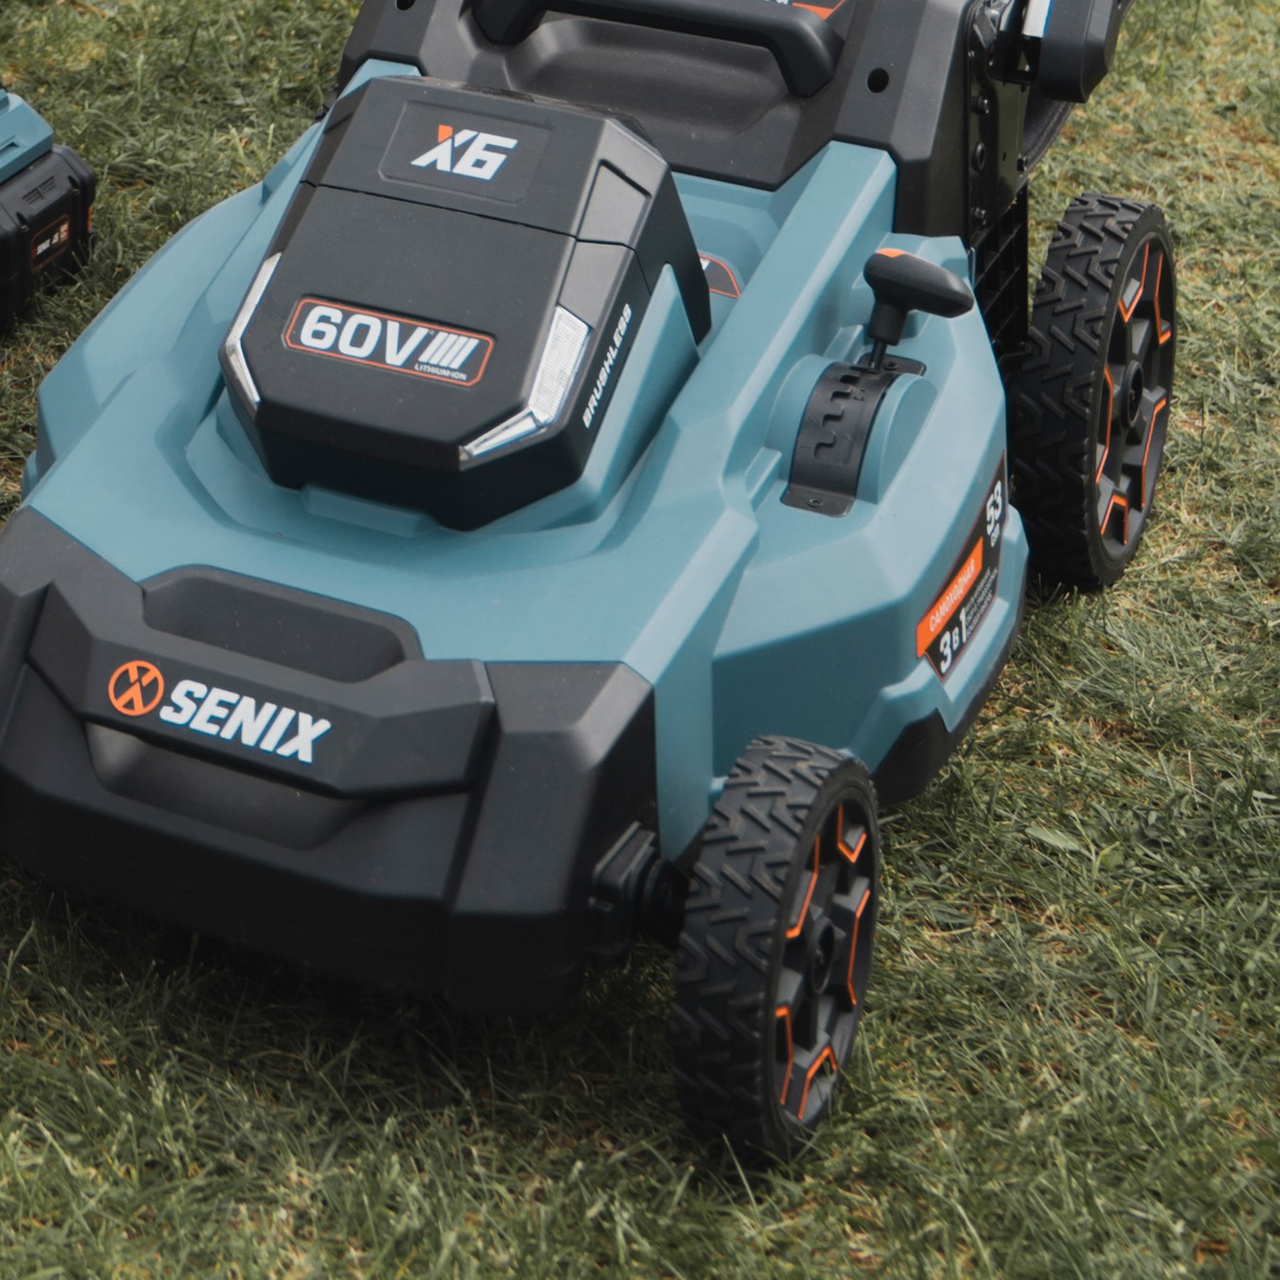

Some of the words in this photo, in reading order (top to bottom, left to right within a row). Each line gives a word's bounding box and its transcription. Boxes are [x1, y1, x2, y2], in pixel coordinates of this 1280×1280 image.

[410, 124, 519, 181] X6
[300, 305, 429, 367] 60V
[582, 303, 632, 429] BRUSHLESS
[414, 362, 468, 381] LITHIUM-ION
[986, 480, 1002, 536] 53
[939, 630, 952, 673] 3
[959, 606, 967, 643] 1
[159, 679, 331, 763] SENIX
